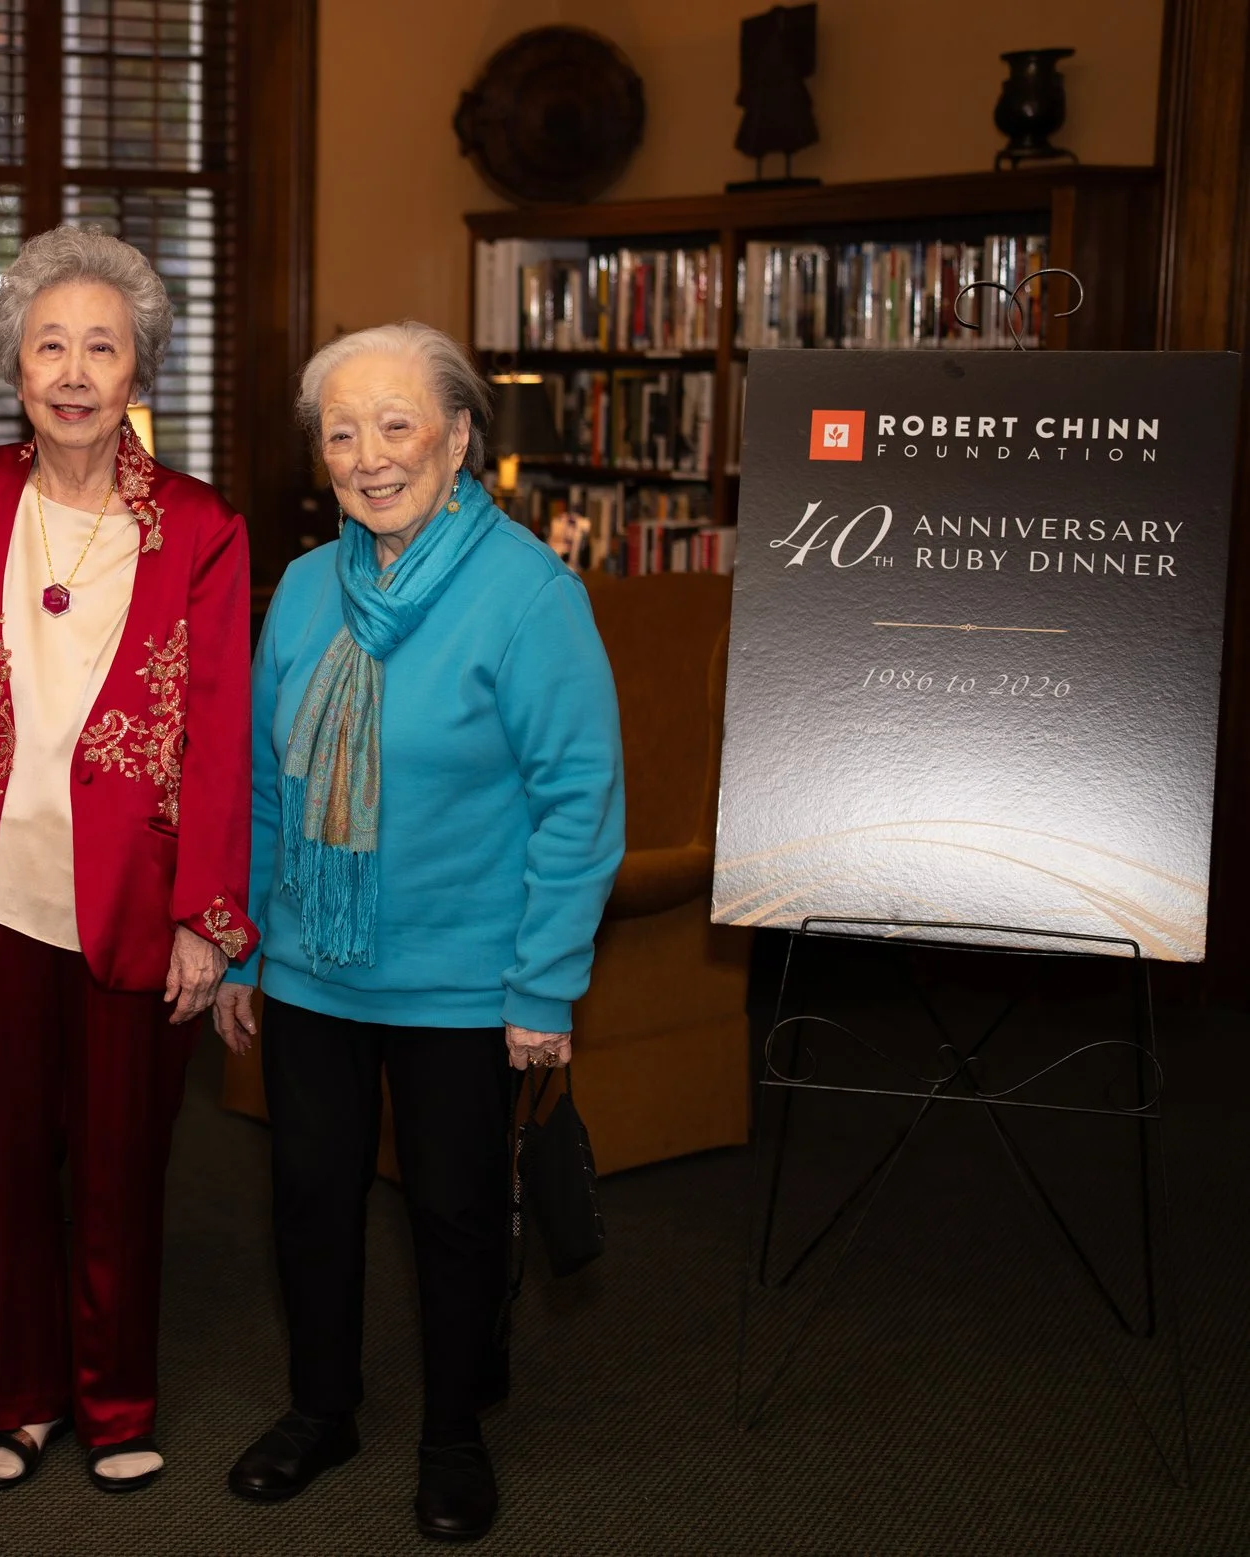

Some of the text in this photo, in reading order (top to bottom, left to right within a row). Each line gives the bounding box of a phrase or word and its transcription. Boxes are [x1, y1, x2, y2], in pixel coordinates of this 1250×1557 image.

[878, 415, 1160, 441] ROBERT CHINN
[877, 443, 1156, 463] FOUNDATION
[913, 514, 1183, 543] ANNIVERSARY
[915, 547, 1178, 577] RUBY DINNER
[862, 668, 1074, 698] 1986 to 2026
